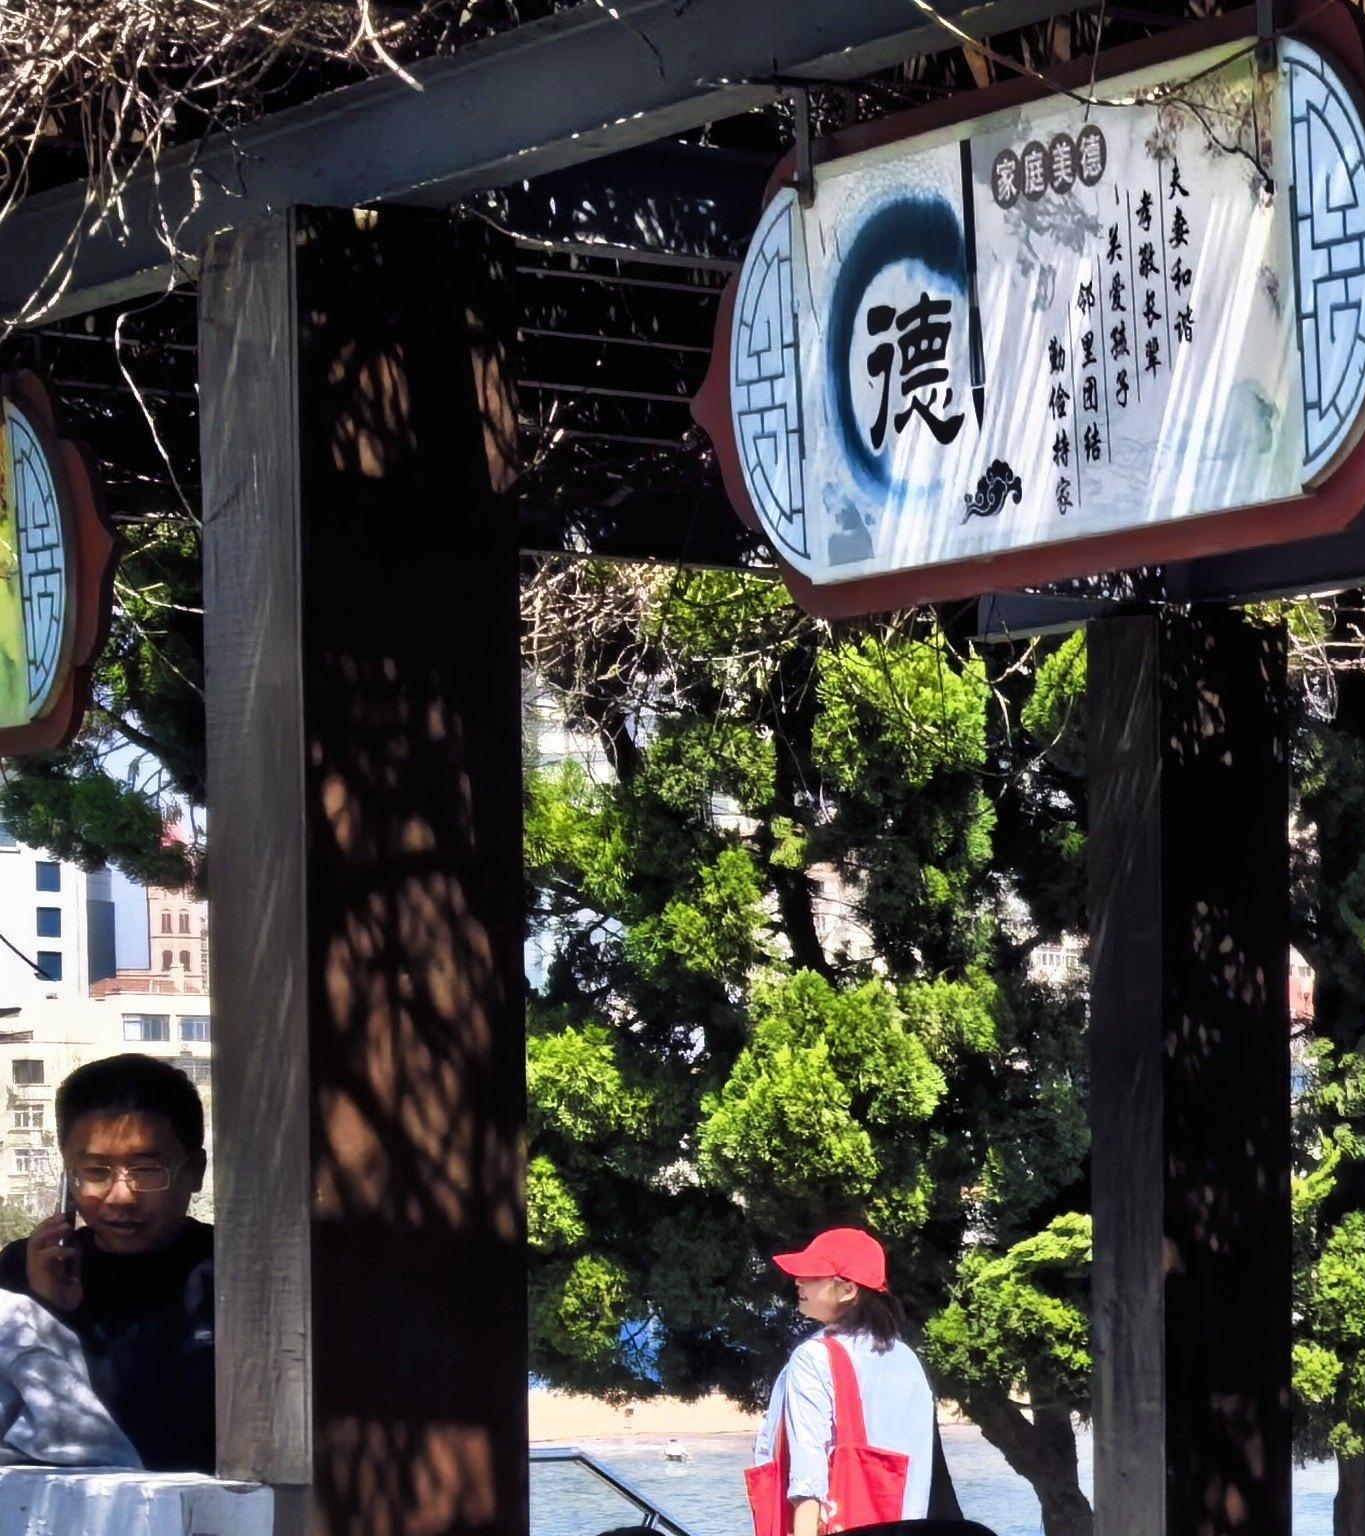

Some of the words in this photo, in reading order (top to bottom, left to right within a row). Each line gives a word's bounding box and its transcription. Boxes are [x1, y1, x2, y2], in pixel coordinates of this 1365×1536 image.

[995, 133, 1101, 203] 家庭美德
[1169, 156, 1194, 343] 夫妻和谐
[867, 291, 965, 456] 德
[1077, 281, 1102, 464] 邻里团结
[1107, 223, 1131, 408] 关爱孩子
[1136, 190, 1161, 378] 孝敬长辈
[1048, 335, 1073, 515] 勤俭持家
